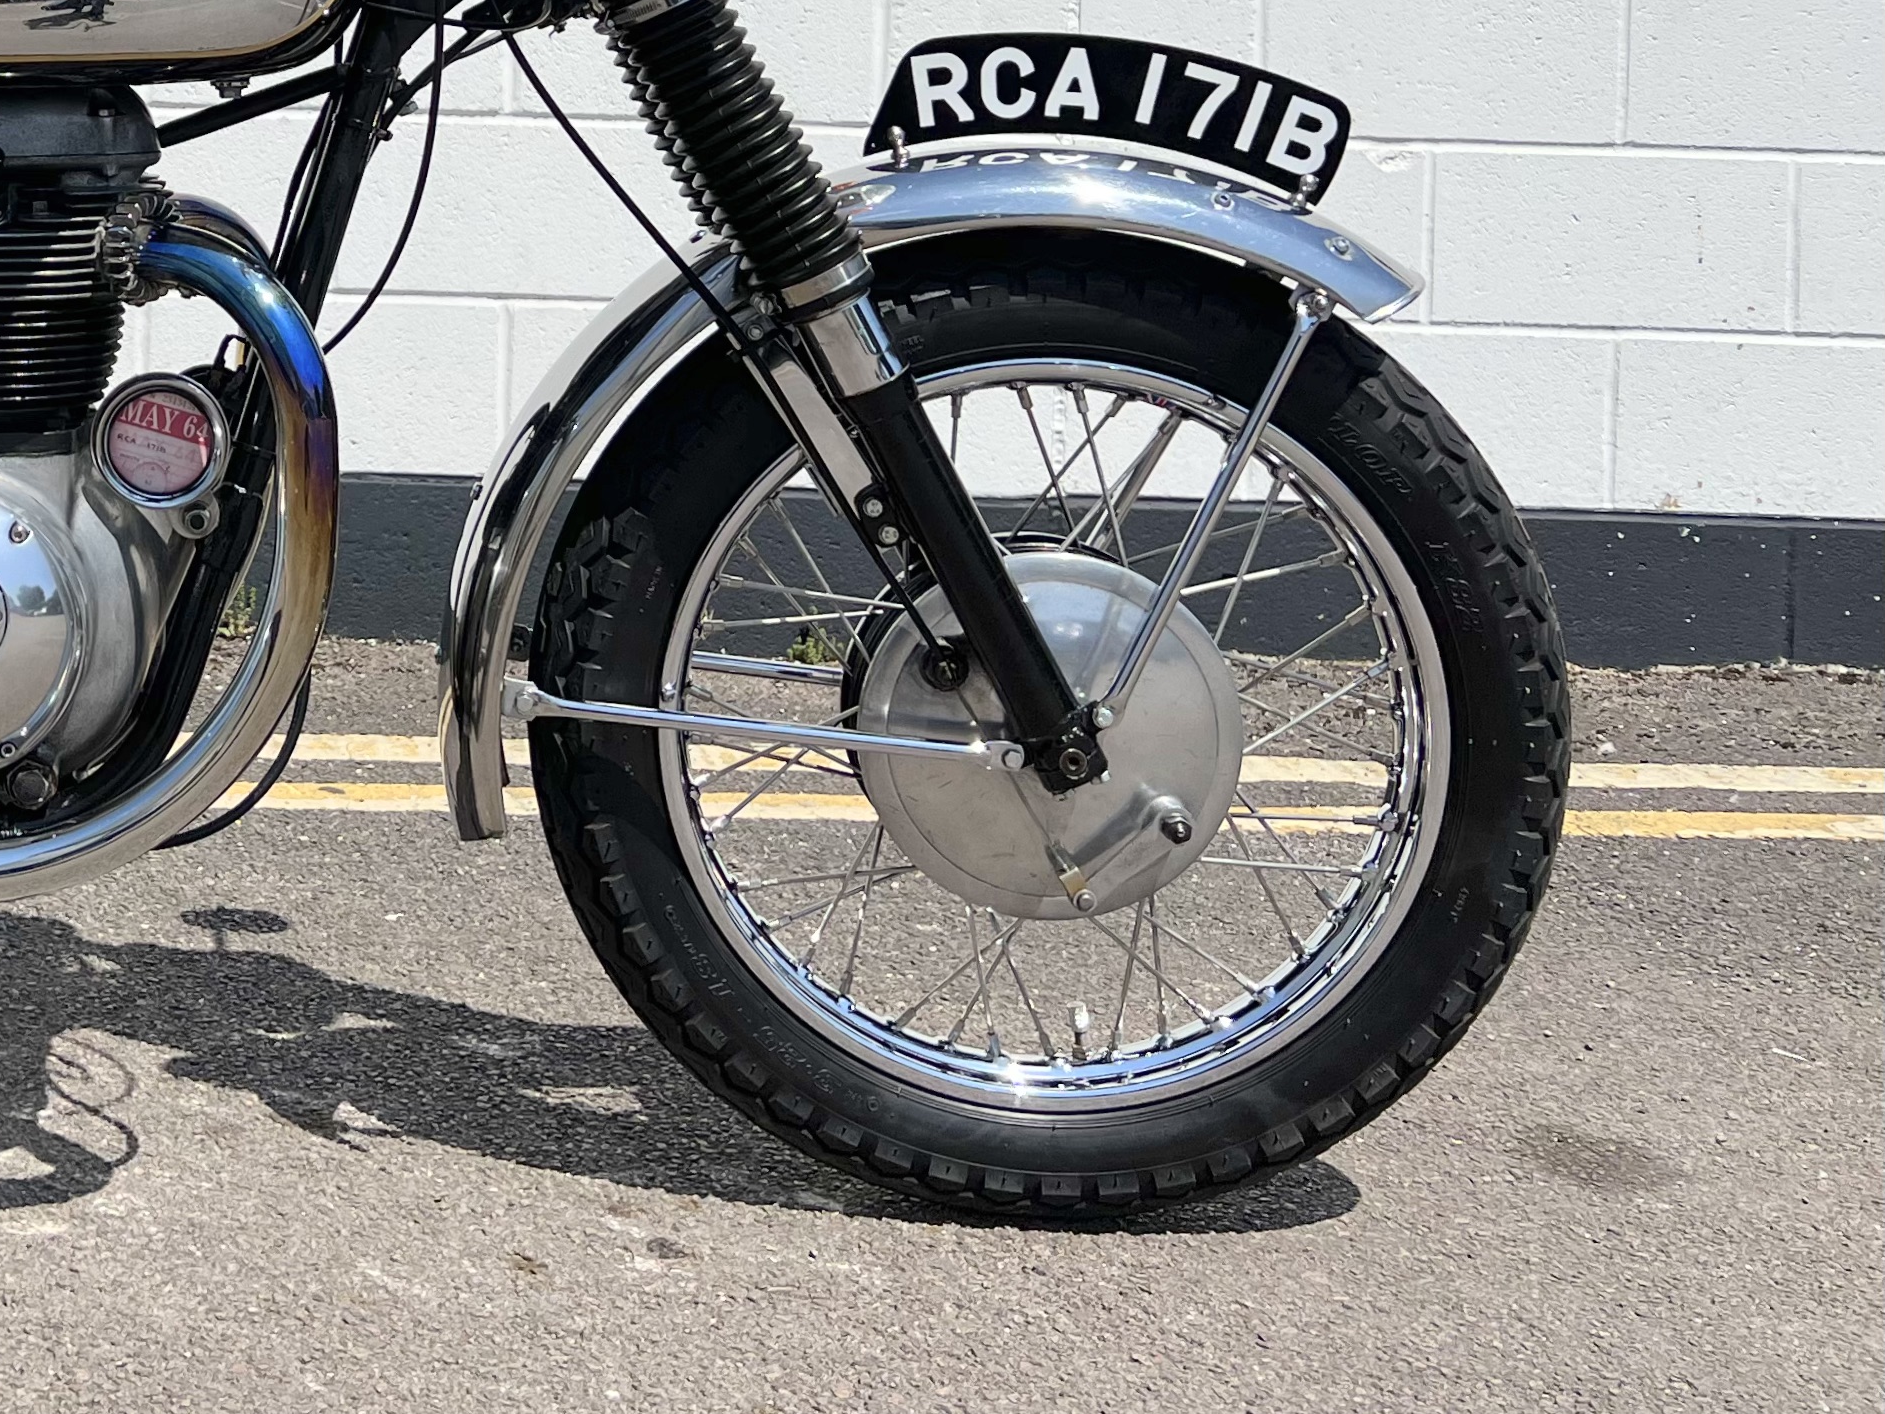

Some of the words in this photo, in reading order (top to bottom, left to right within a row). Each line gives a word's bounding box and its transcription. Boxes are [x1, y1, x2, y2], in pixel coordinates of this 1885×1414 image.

[910, 46, 1100, 128] RCA
[1135, 52, 1339, 176] 171B
[116, 432, 137, 445] RCA
[120, 399, 179, 434] MAY
[183, 414, 210, 440] 64
